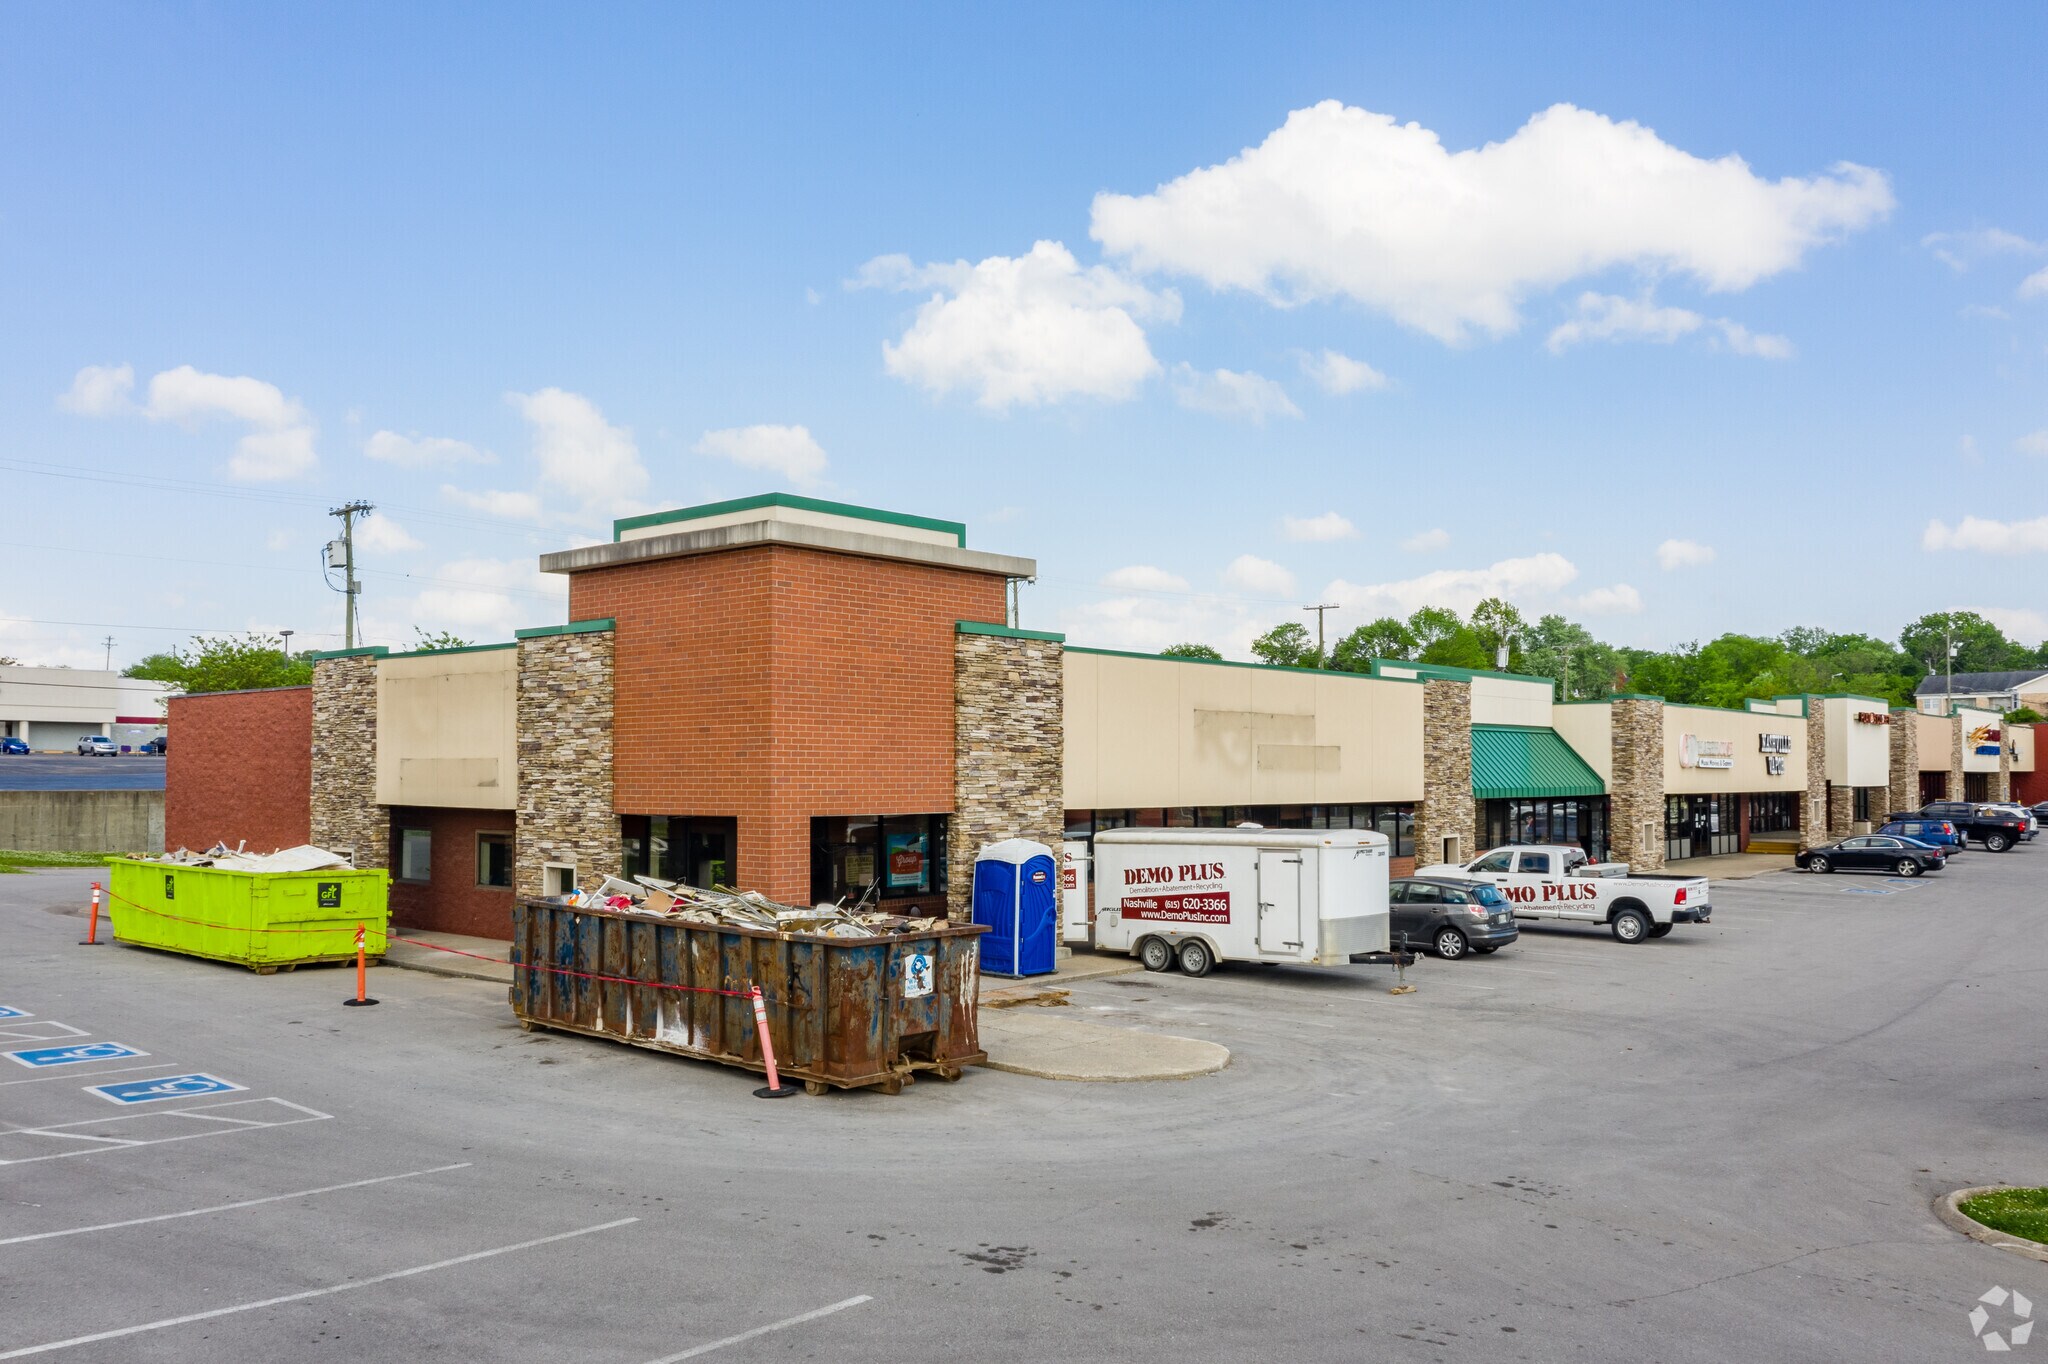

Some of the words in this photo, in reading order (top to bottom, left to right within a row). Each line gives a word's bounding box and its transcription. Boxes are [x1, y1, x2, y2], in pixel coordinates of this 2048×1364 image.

[1759, 733, 1791, 754] NASHVILLE
[1124, 866, 1173, 885] DEMO
[1178, 863, 1225, 882] PLUS
[321, 887, 337, 899] GFL
[1541, 883, 1597, 901] PLUS
[1123, 898, 1158, 909] Nashville
[1164, 900, 1180, 909] (615)
[1182, 898, 1227, 911] 620-3366
[1141, 910, 1228, 922] www.DemoPlusInc.com
